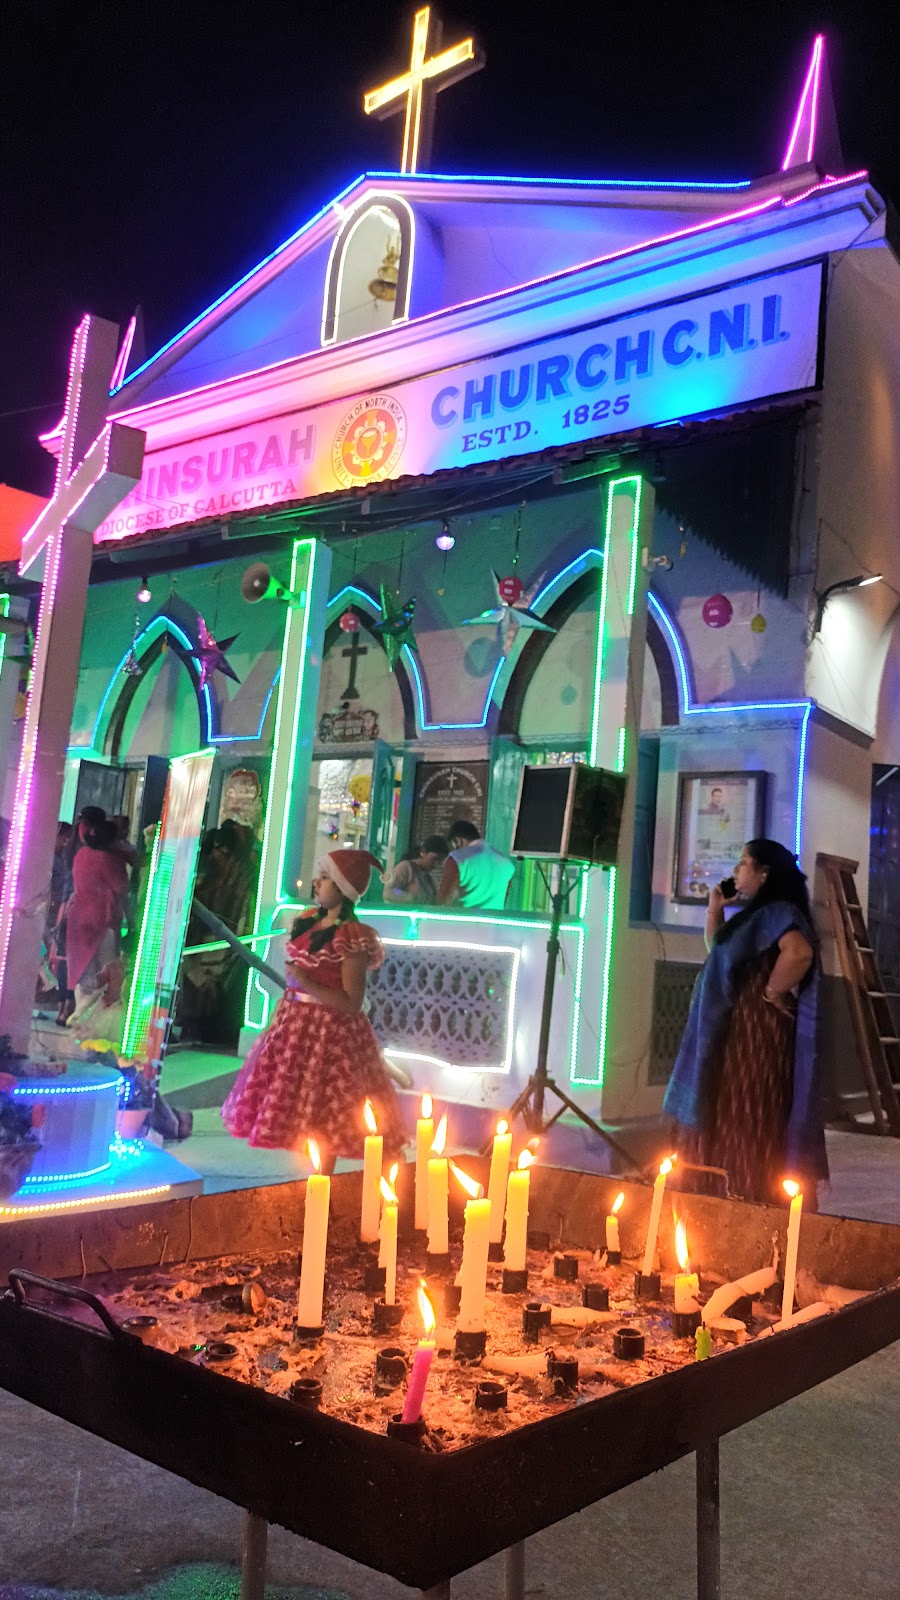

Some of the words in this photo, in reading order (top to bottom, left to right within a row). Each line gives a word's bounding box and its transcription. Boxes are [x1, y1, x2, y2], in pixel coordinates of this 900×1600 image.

[431, 329, 656, 428] CHURCH
[662, 294, 791, 369] C.N.I.
[335, 411, 355, 450] CHURCH
[354, 402, 364, 417] OF
[365, 397, 388, 410] NORTH
[387, 400, 404, 424] INDIA
[462, 419, 538, 453] ESTD.
[562, 394, 630, 428] 1825
[101, 509, 165, 536] DIOCESE
[168, 502, 190, 519] OF
[194, 478, 297, 514] CALCUTTA
